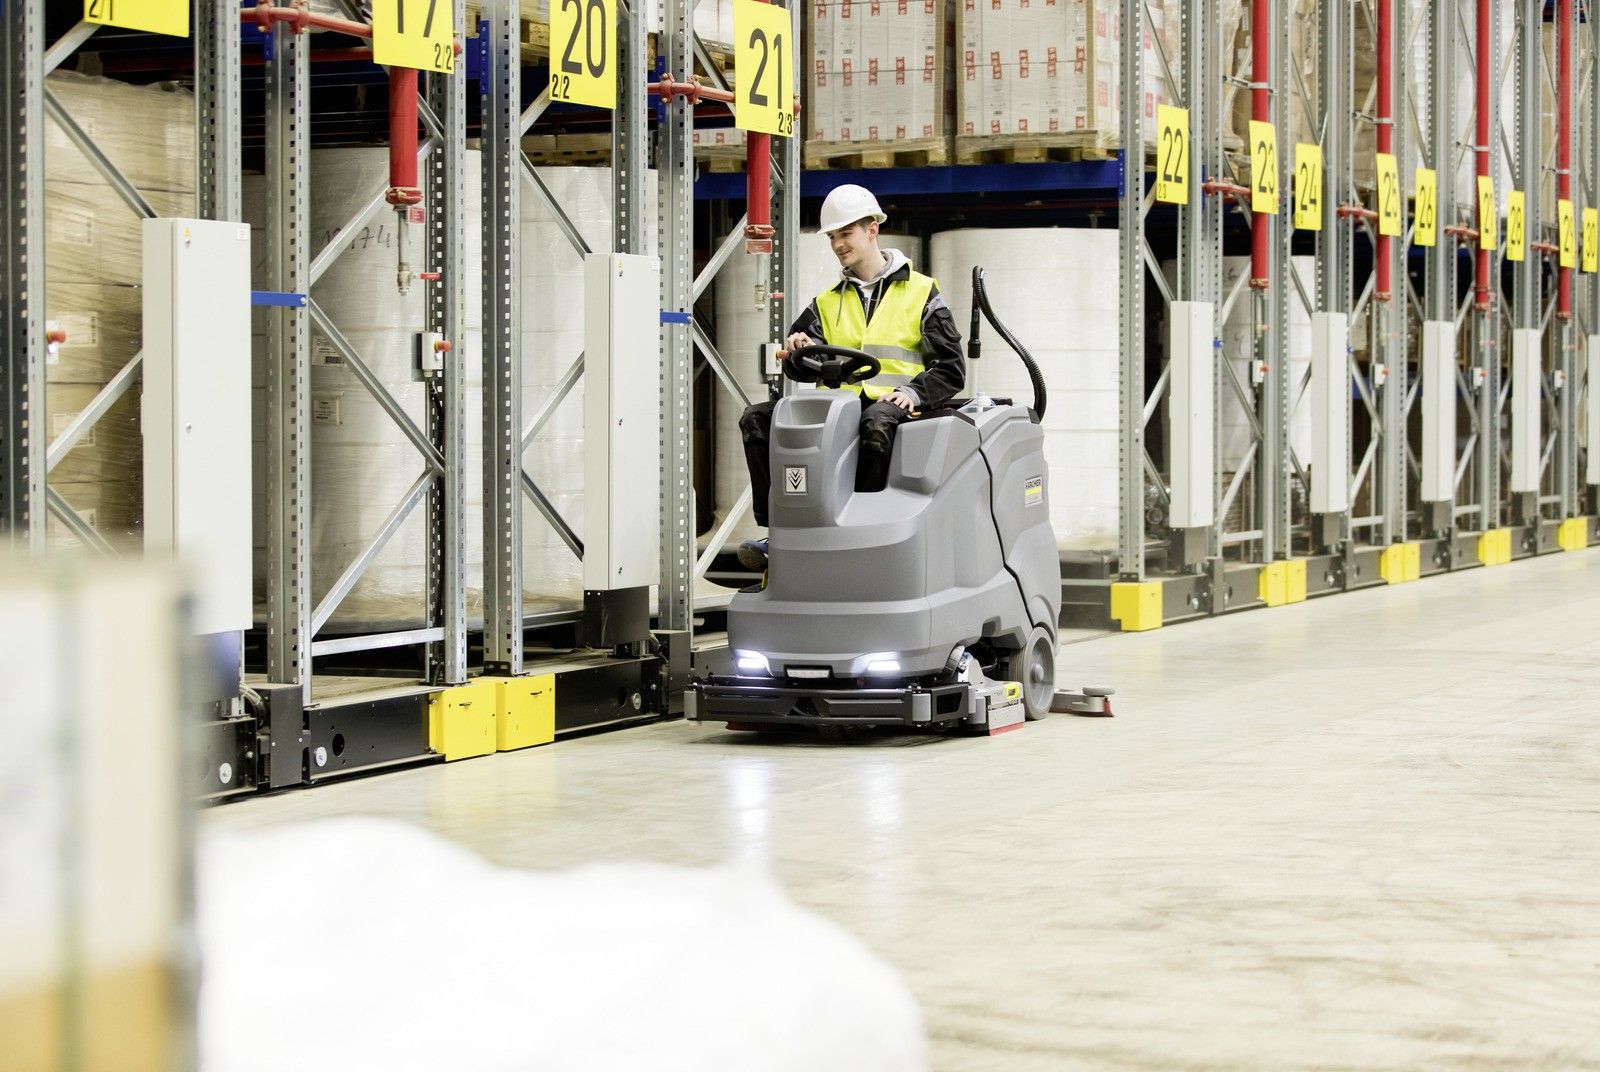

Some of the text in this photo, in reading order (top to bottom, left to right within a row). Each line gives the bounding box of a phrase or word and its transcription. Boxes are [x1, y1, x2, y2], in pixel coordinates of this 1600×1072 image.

[434, 42, 452, 70] 2/2
[561, 0, 606, 78] 20
[552, 73, 570, 99] 2/2
[749, 28, 782, 109] 21
[778, 111, 793, 135] 2/3
[1163, 126, 1183, 184] 22
[1258, 141, 1275, 194] 23
[1300, 162, 1317, 212] 24
[1419, 185, 1433, 229] 26
